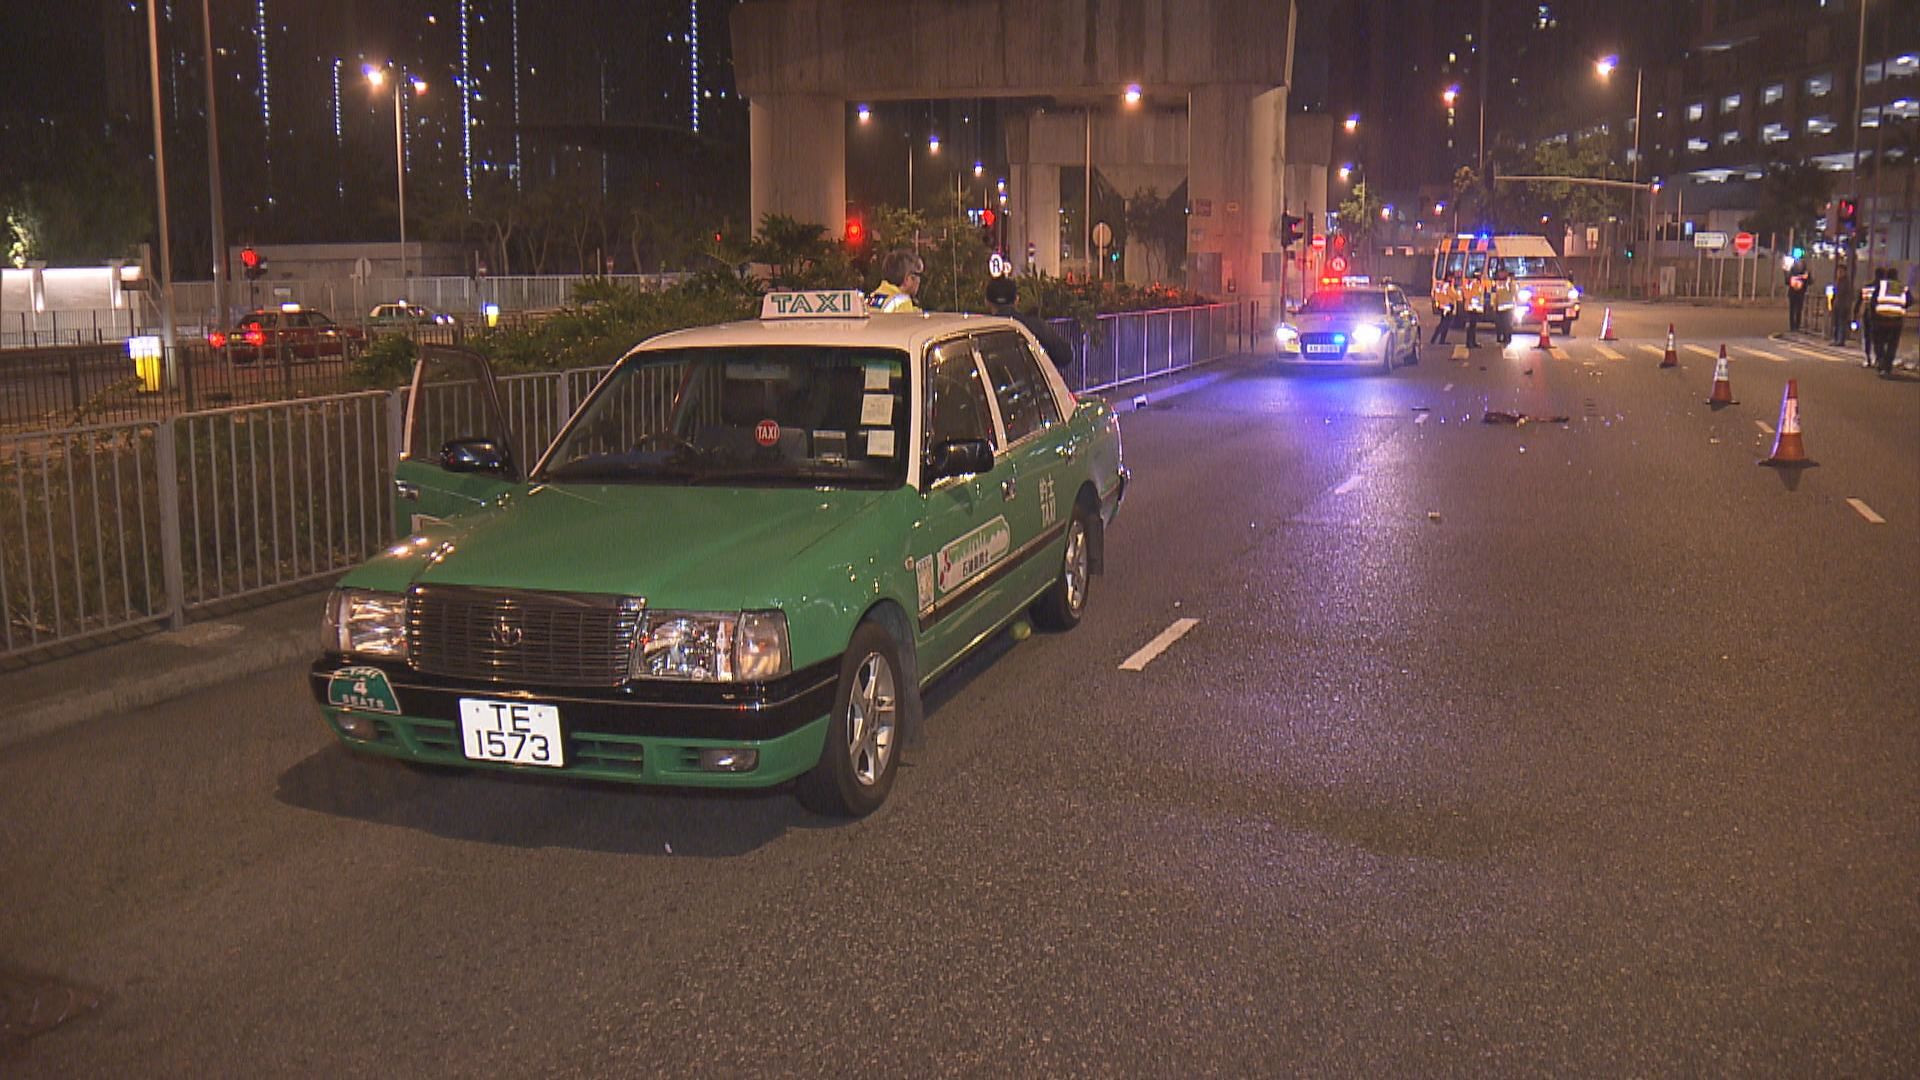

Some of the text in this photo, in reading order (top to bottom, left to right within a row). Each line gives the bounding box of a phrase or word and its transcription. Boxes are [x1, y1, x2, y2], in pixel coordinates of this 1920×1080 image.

[771, 293, 851, 313] TAXI
[757, 425, 778, 440] TAXI
[353, 677, 368, 696] 4
[489, 704, 531, 733] TE
[476, 730, 550, 761] 1573
